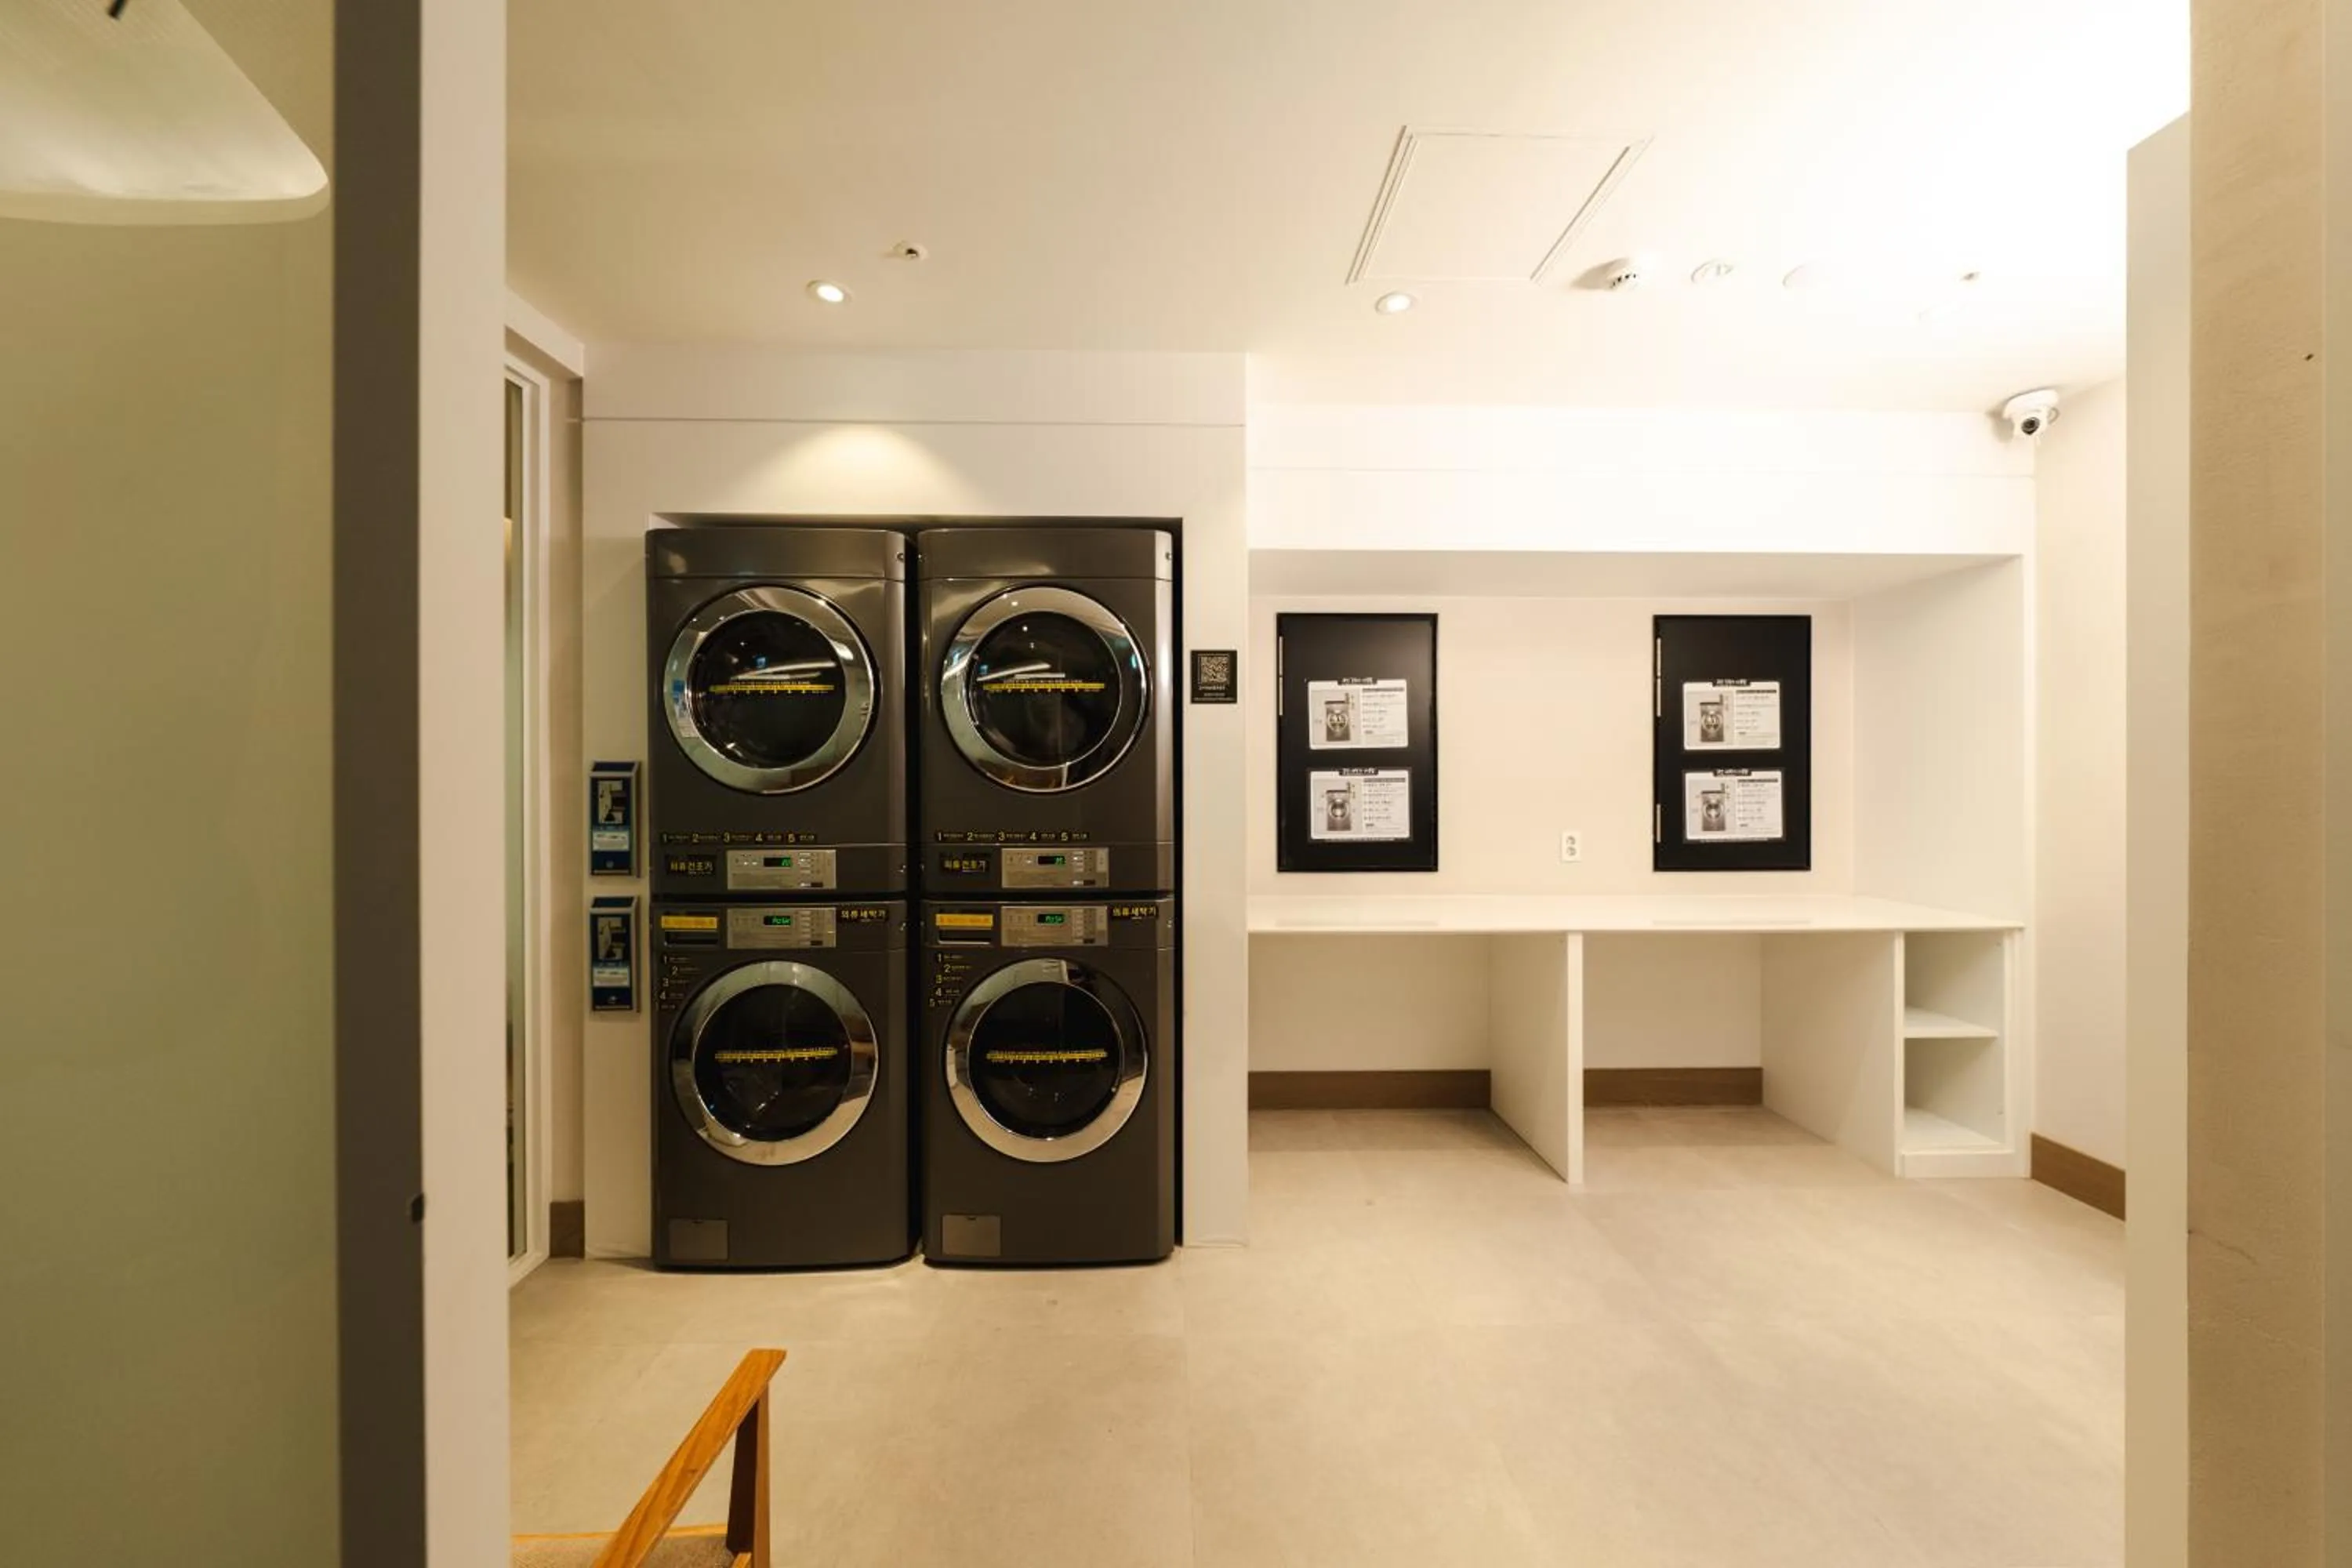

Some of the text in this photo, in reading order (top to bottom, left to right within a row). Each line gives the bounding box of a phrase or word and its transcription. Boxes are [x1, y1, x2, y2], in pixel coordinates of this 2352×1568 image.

[692, 833, 699, 843] 2
[723, 832, 730, 842] 3
[755, 833, 763, 842] 4
[788, 833, 796, 843] 5
[967, 832, 973, 841] 2
[998, 831, 1005, 841] 3
[1029, 832, 1036, 841] 4
[1061, 832, 1068, 841] 5
[944, 964, 950, 973] 2
